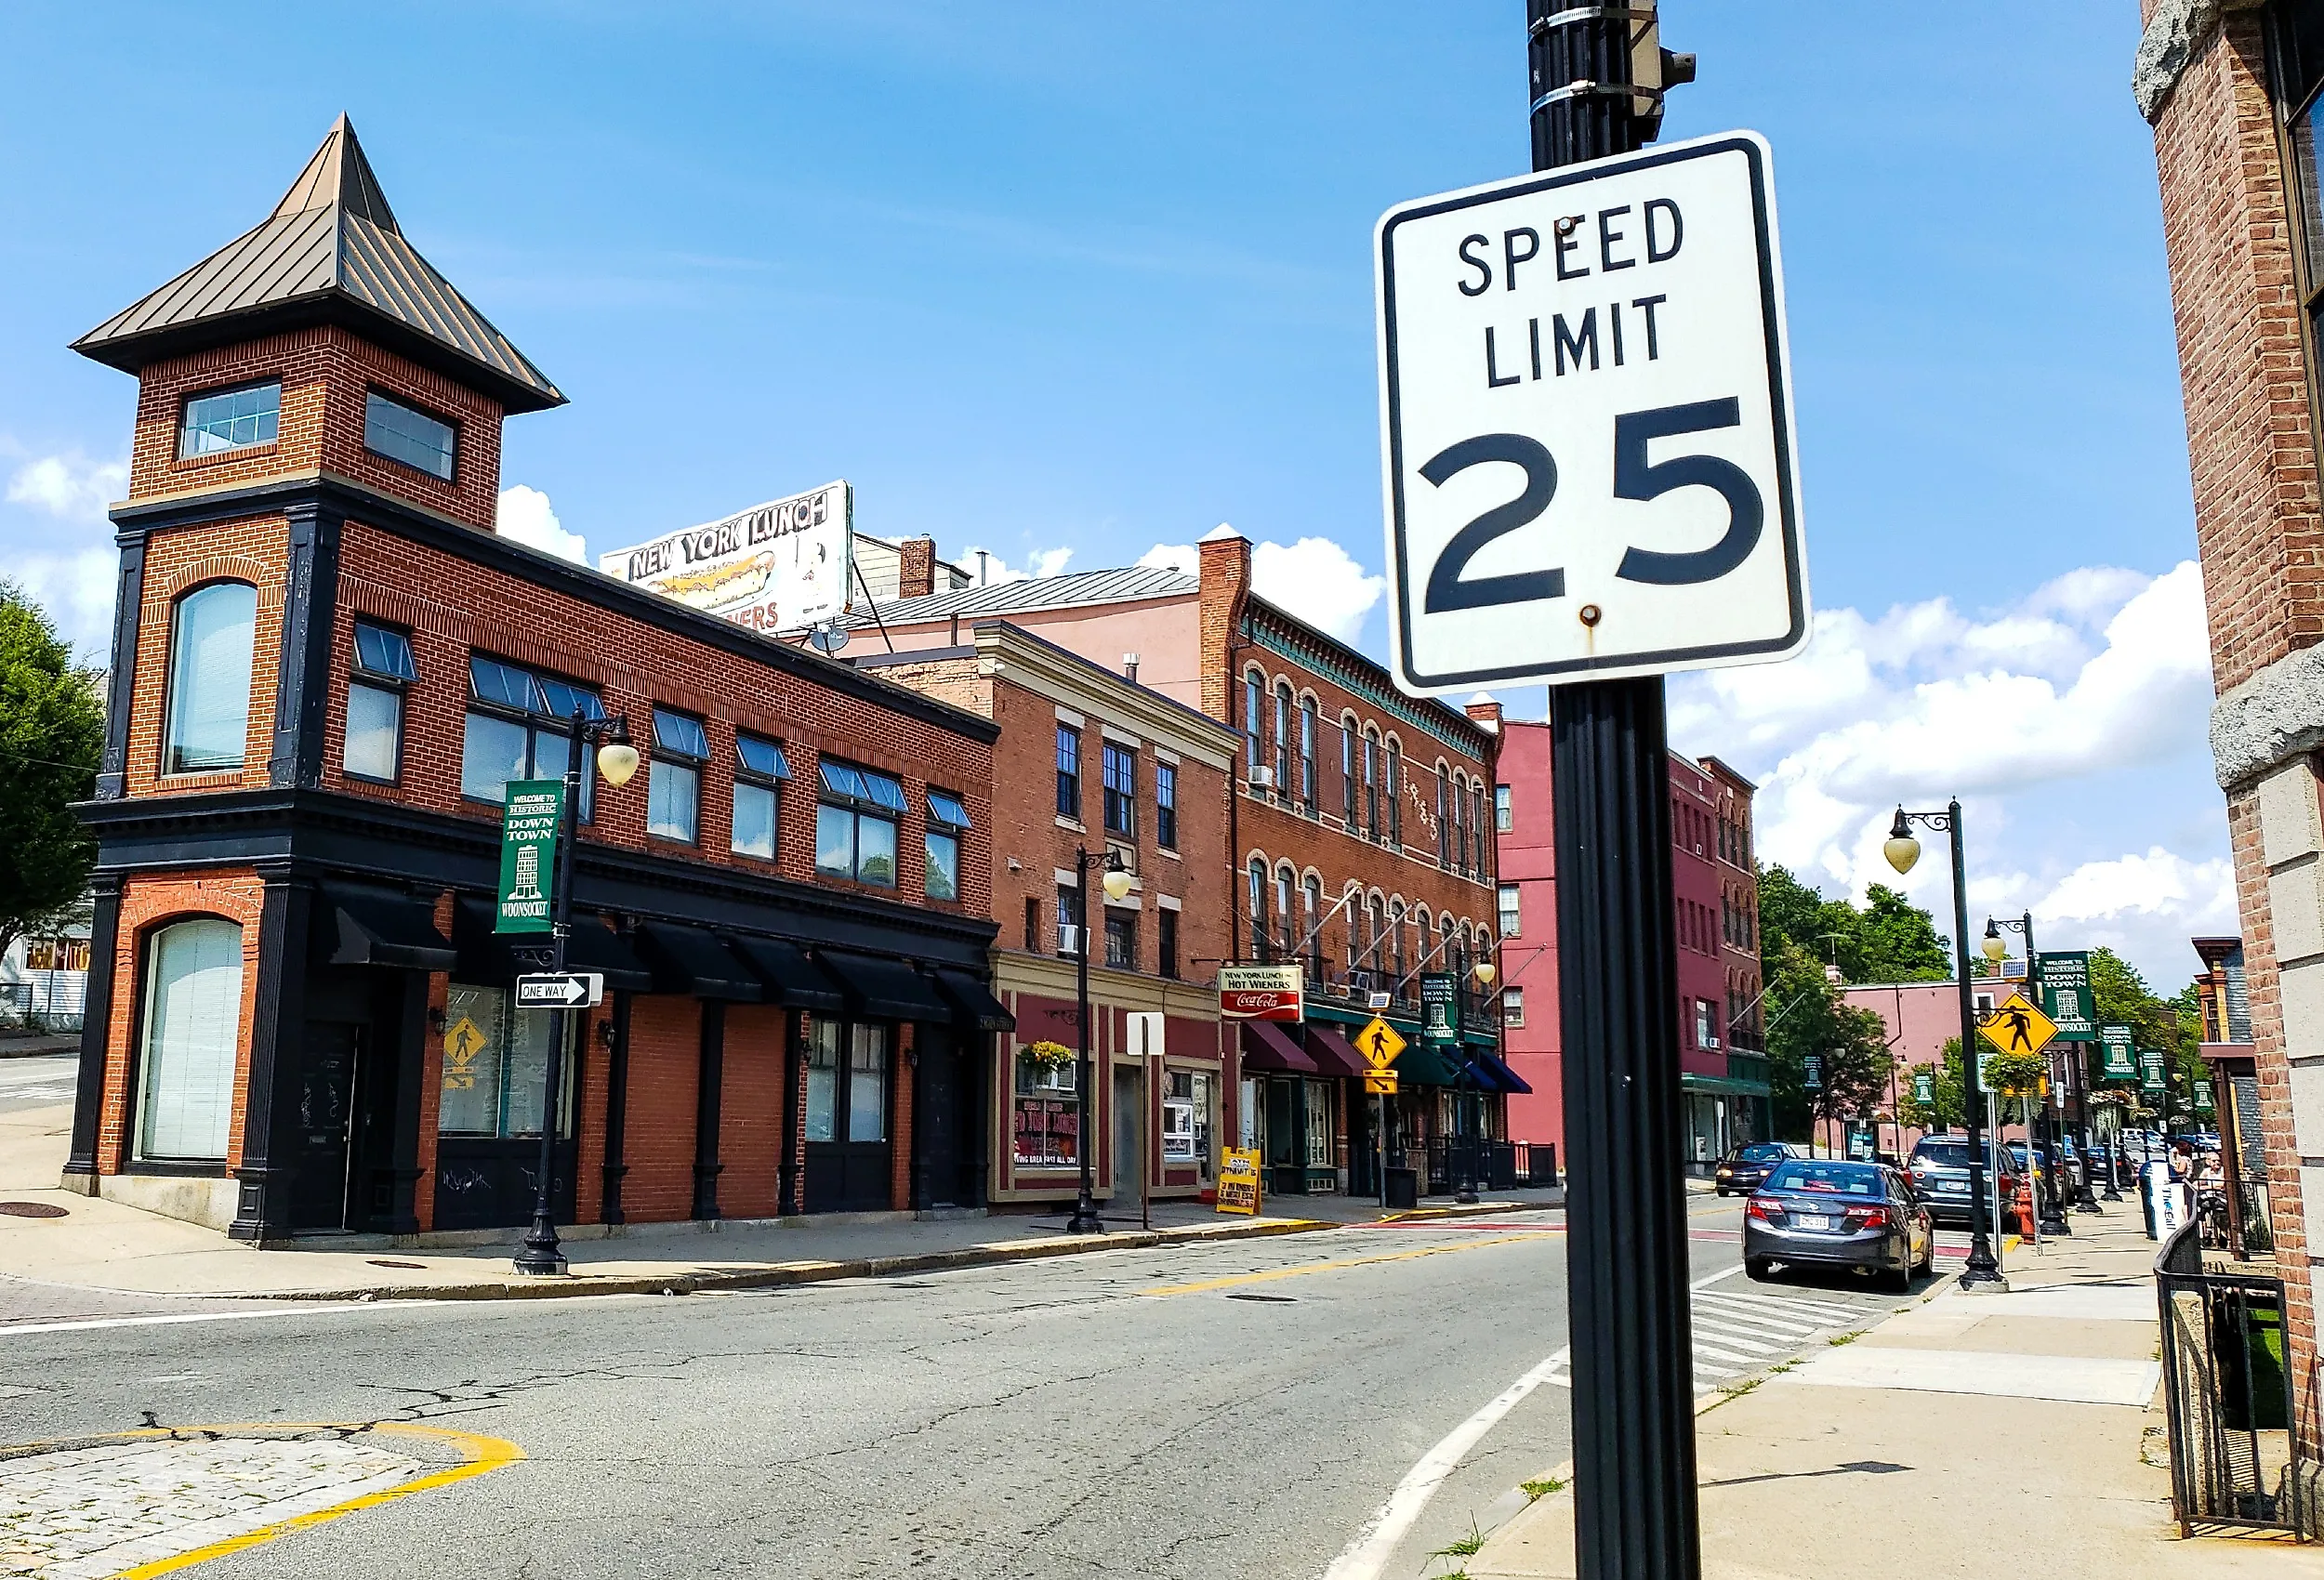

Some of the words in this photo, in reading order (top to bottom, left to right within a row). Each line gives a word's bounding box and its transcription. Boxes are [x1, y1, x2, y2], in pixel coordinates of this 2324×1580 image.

[1458, 197, 1684, 296] SPEED
[1485, 293, 1667, 388] LIMIT
[1418, 395, 1764, 614] 25
[629, 539, 674, 582] NEW
[680, 519, 743, 564] YORK
[748, 492, 828, 546] LUNCH
[513, 795, 546, 804] WELCOME
[546, 794, 556, 802] TO
[508, 804, 557, 814] HISTORIC
[508, 817, 555, 829] DOWN
[507, 829, 553, 841] TOWN
[502, 901, 548, 917] WOONSOCKET
[1224, 971, 1241, 980] NEW
[1242, 971, 1261, 980] YORK
[1261, 971, 1284, 980] LUNCH
[522, 985, 543, 997] ONE
[545, 984, 567, 997] WAY
[1228, 980, 1246, 989] HOT
[1249, 980, 1290, 989] WIENERS
[2055, 1022, 2092, 1032] ONSOCKET
